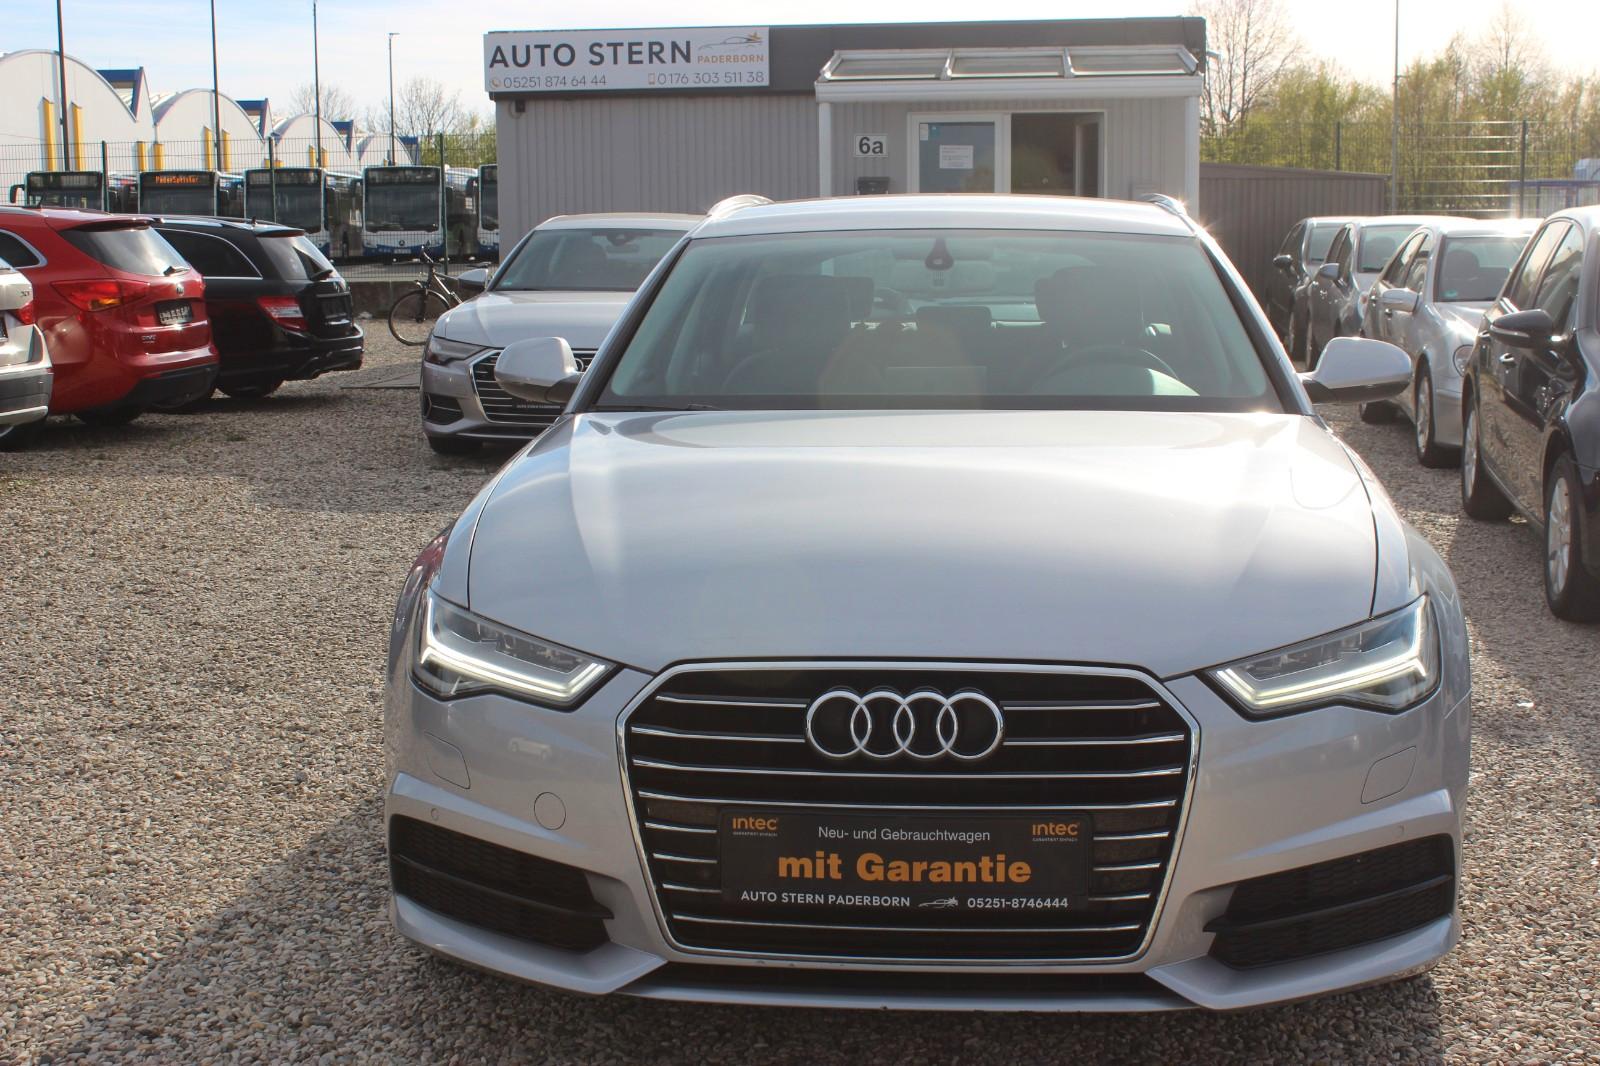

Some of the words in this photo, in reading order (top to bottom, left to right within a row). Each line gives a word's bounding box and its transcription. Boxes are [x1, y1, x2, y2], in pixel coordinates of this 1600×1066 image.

[489, 43, 576, 68] AUTO
[589, 40, 692, 66] STERN
[697, 54, 764, 64] PADERBORN
[503, 76, 541, 89] 05251
[545, 75, 567, 88] 874
[570, 75, 587, 87] 64
[590, 74, 607, 86] 44
[657, 73, 689, 85] 0176
[693, 72, 720, 84] 303
[724, 71, 742, 83] 511
[746, 71, 764, 83] 38
[858, 136, 884, 155] 6a
[732, 816, 777, 830] intec
[1032, 822, 1078, 836] intec
[818, 826, 849, 839] Neu-
[853, 827, 877, 840] und
[880, 828, 990, 842] Gebrauchtwagen
[778, 851, 842, 880] mit
[856, 852, 1032, 883] Garantie
[741, 890, 777, 903] AUTO
[781, 892, 824, 905] STERN
[828, 894, 910, 907] PADERBORN
[967, 896, 1068, 909] 05251-8746444
